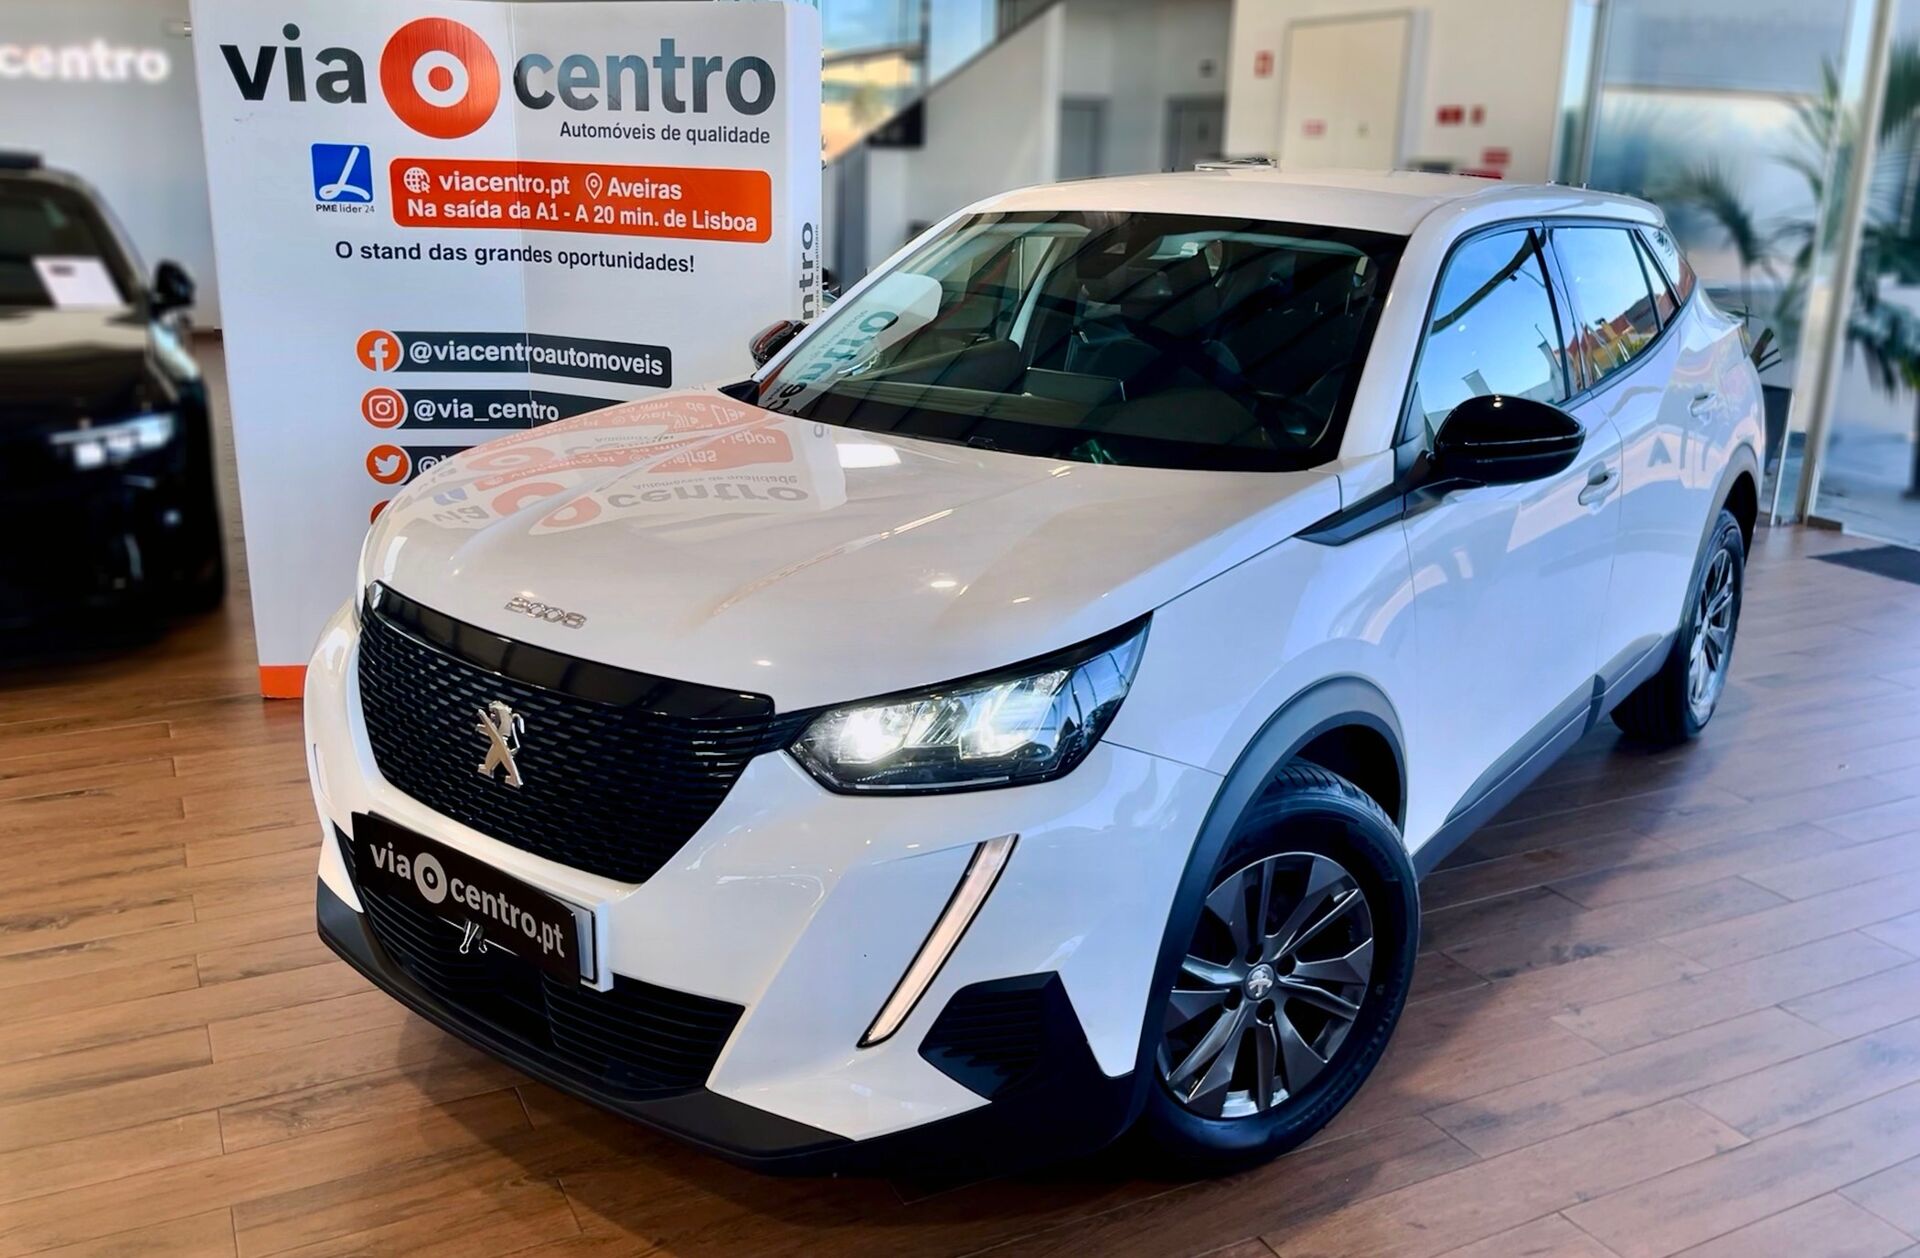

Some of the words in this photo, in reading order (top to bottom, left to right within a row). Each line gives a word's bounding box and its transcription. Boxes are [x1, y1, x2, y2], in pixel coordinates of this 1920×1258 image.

[0, 38, 171, 84] centro
[219, 22, 367, 104] via
[513, 38, 776, 116] centro
[560, 121, 656, 141] Automóveis
[661, 124, 681, 141] de
[686, 125, 771, 145] qualidade
[439, 170, 570, 199] viacentro.pt
[607, 176, 683, 200] Aveiras
[315, 203, 338, 213] PME
[407, 199, 437, 218] Na
[444, 199, 502, 219] saída
[508, 201, 532, 219] da
[536, 202, 559, 221] A1
[575, 204, 589, 223] A
[593, 205, 615, 224] 20
[620, 207, 660, 227] min.
[664, 208, 687, 228] de
[692, 210, 758, 232] Lisboa
[335, 241, 353, 259] O
[360, 243, 421, 261] stand
[428, 244, 467, 261] das
[474, 244, 553, 266] grandes
[557, 250, 695, 273] oportunidades!
[409, 341, 664, 376] @viacentroautomoveis
[413, 399, 560, 422] @via_centro
[504, 597, 586, 629] 2008
[370, 842, 411, 880] via
[450, 877, 565, 958] centro.pt
